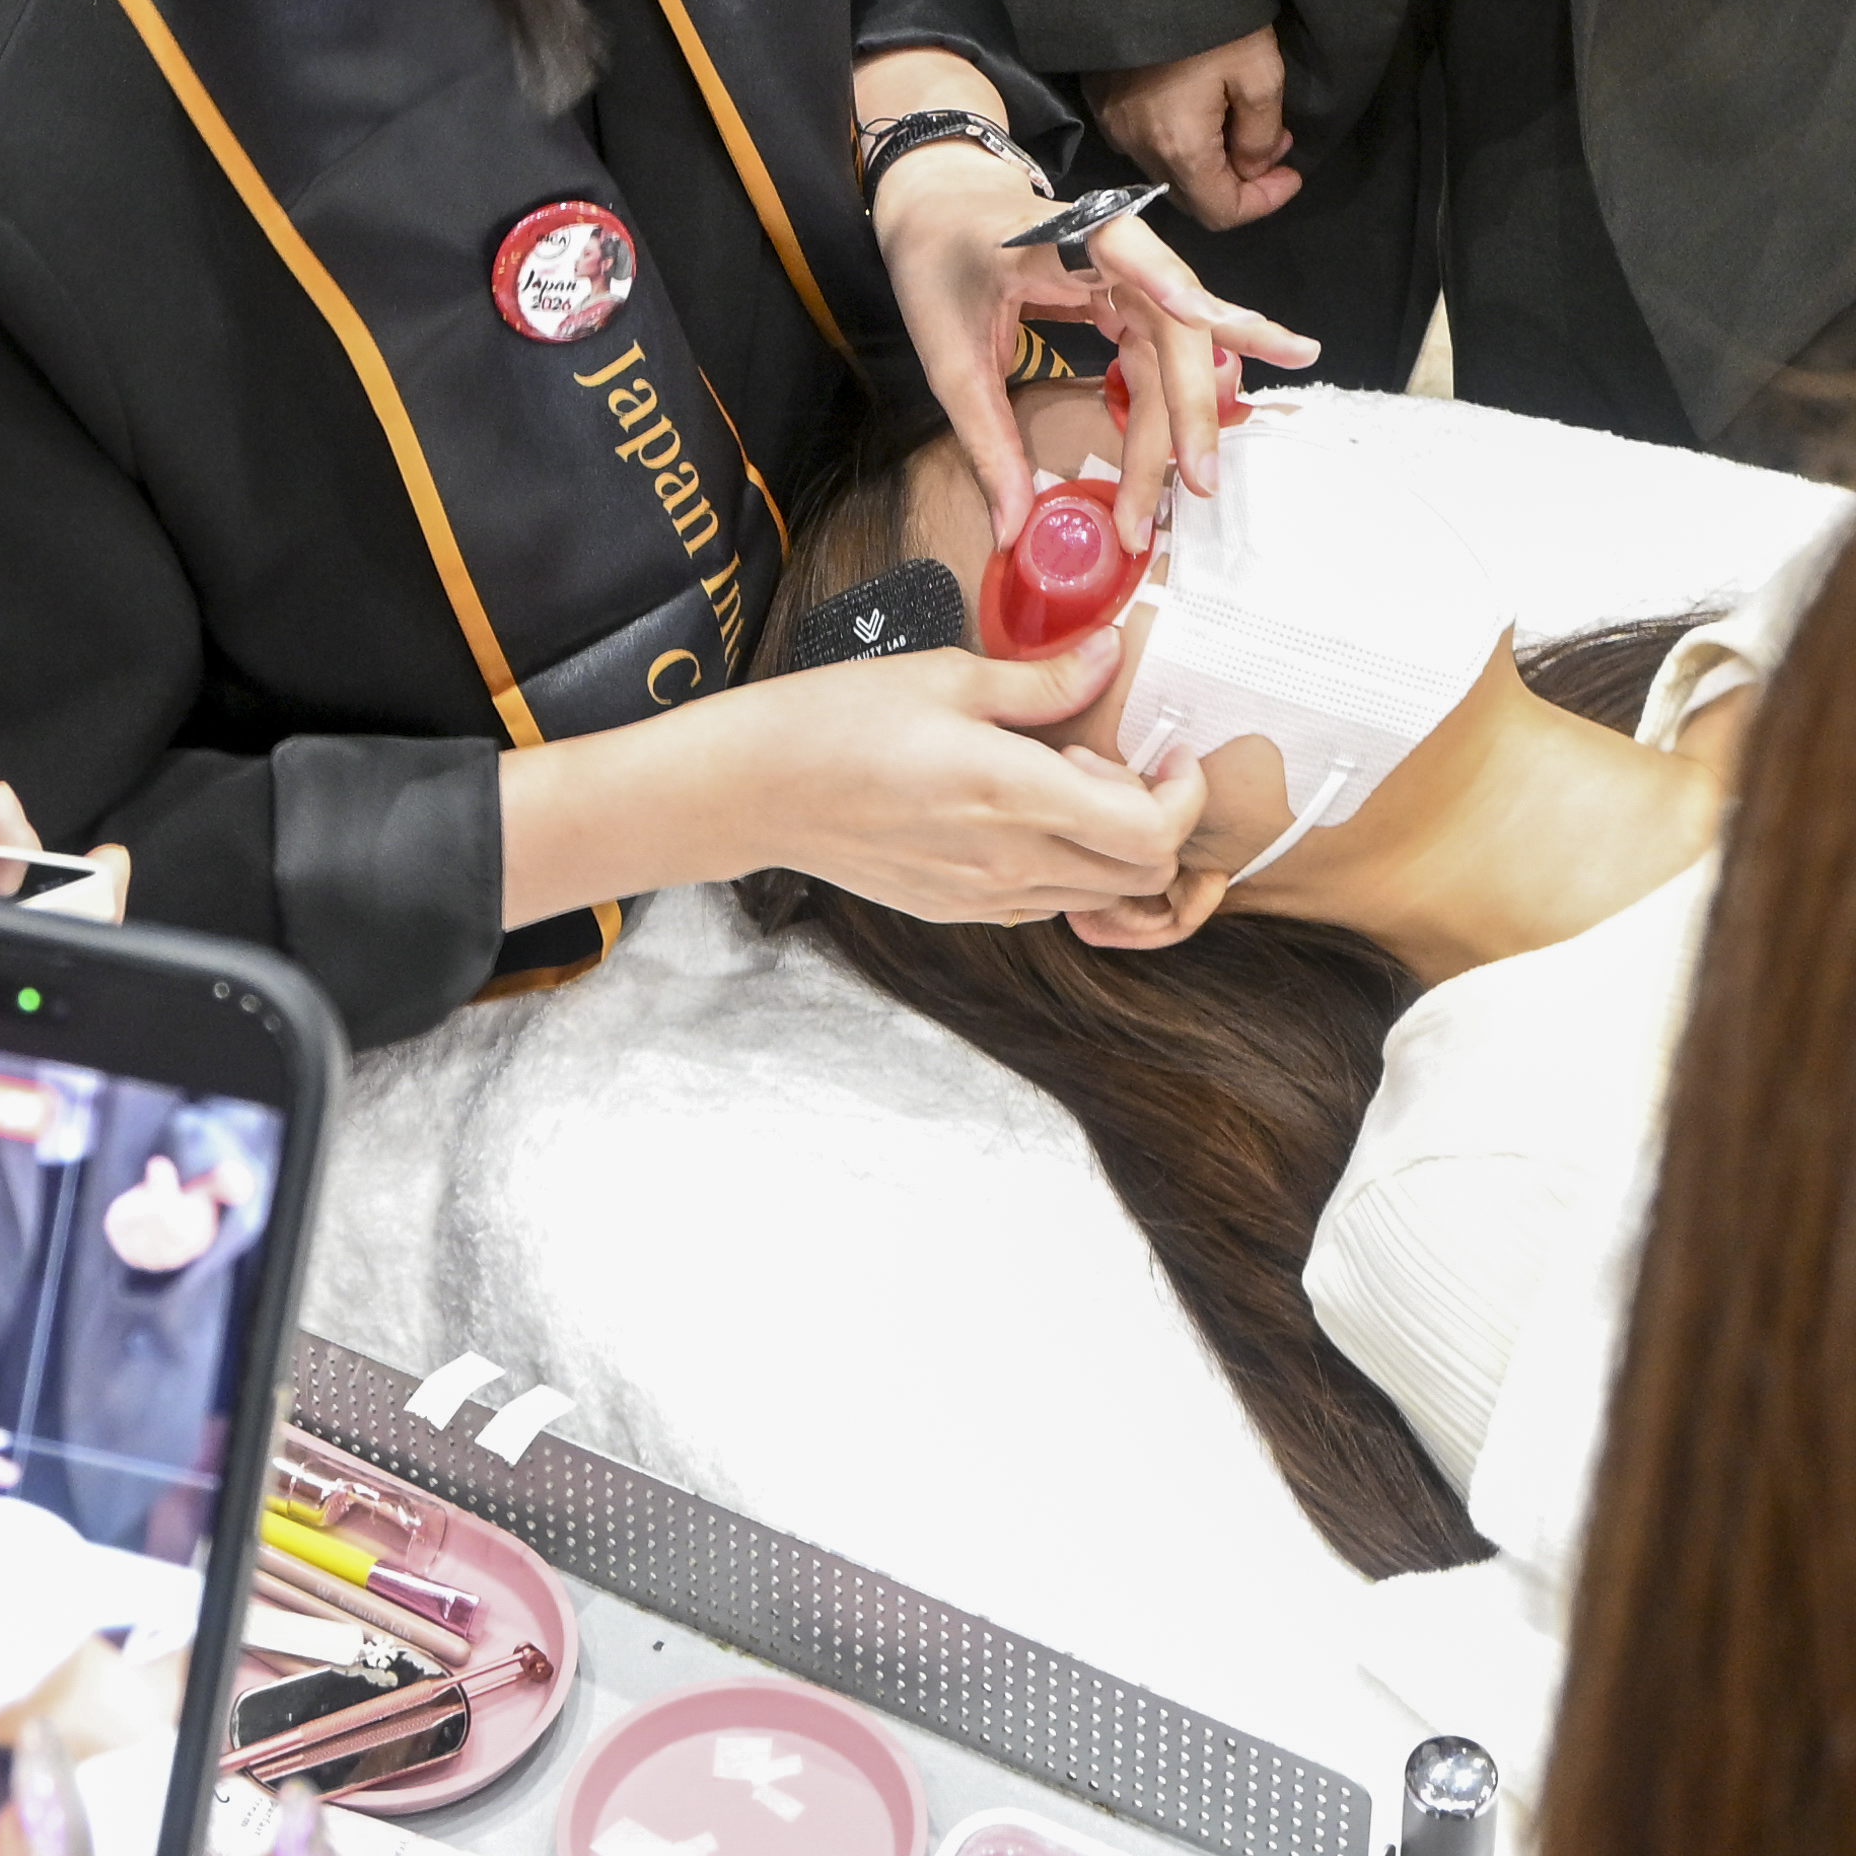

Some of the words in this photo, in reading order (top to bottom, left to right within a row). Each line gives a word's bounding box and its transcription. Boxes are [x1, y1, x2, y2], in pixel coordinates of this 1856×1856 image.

[522, 269, 577, 303] Japan
[531, 296, 571, 311] 2026
[574, 340, 720, 558] Japan
[887, 635, 907, 652] LAB
